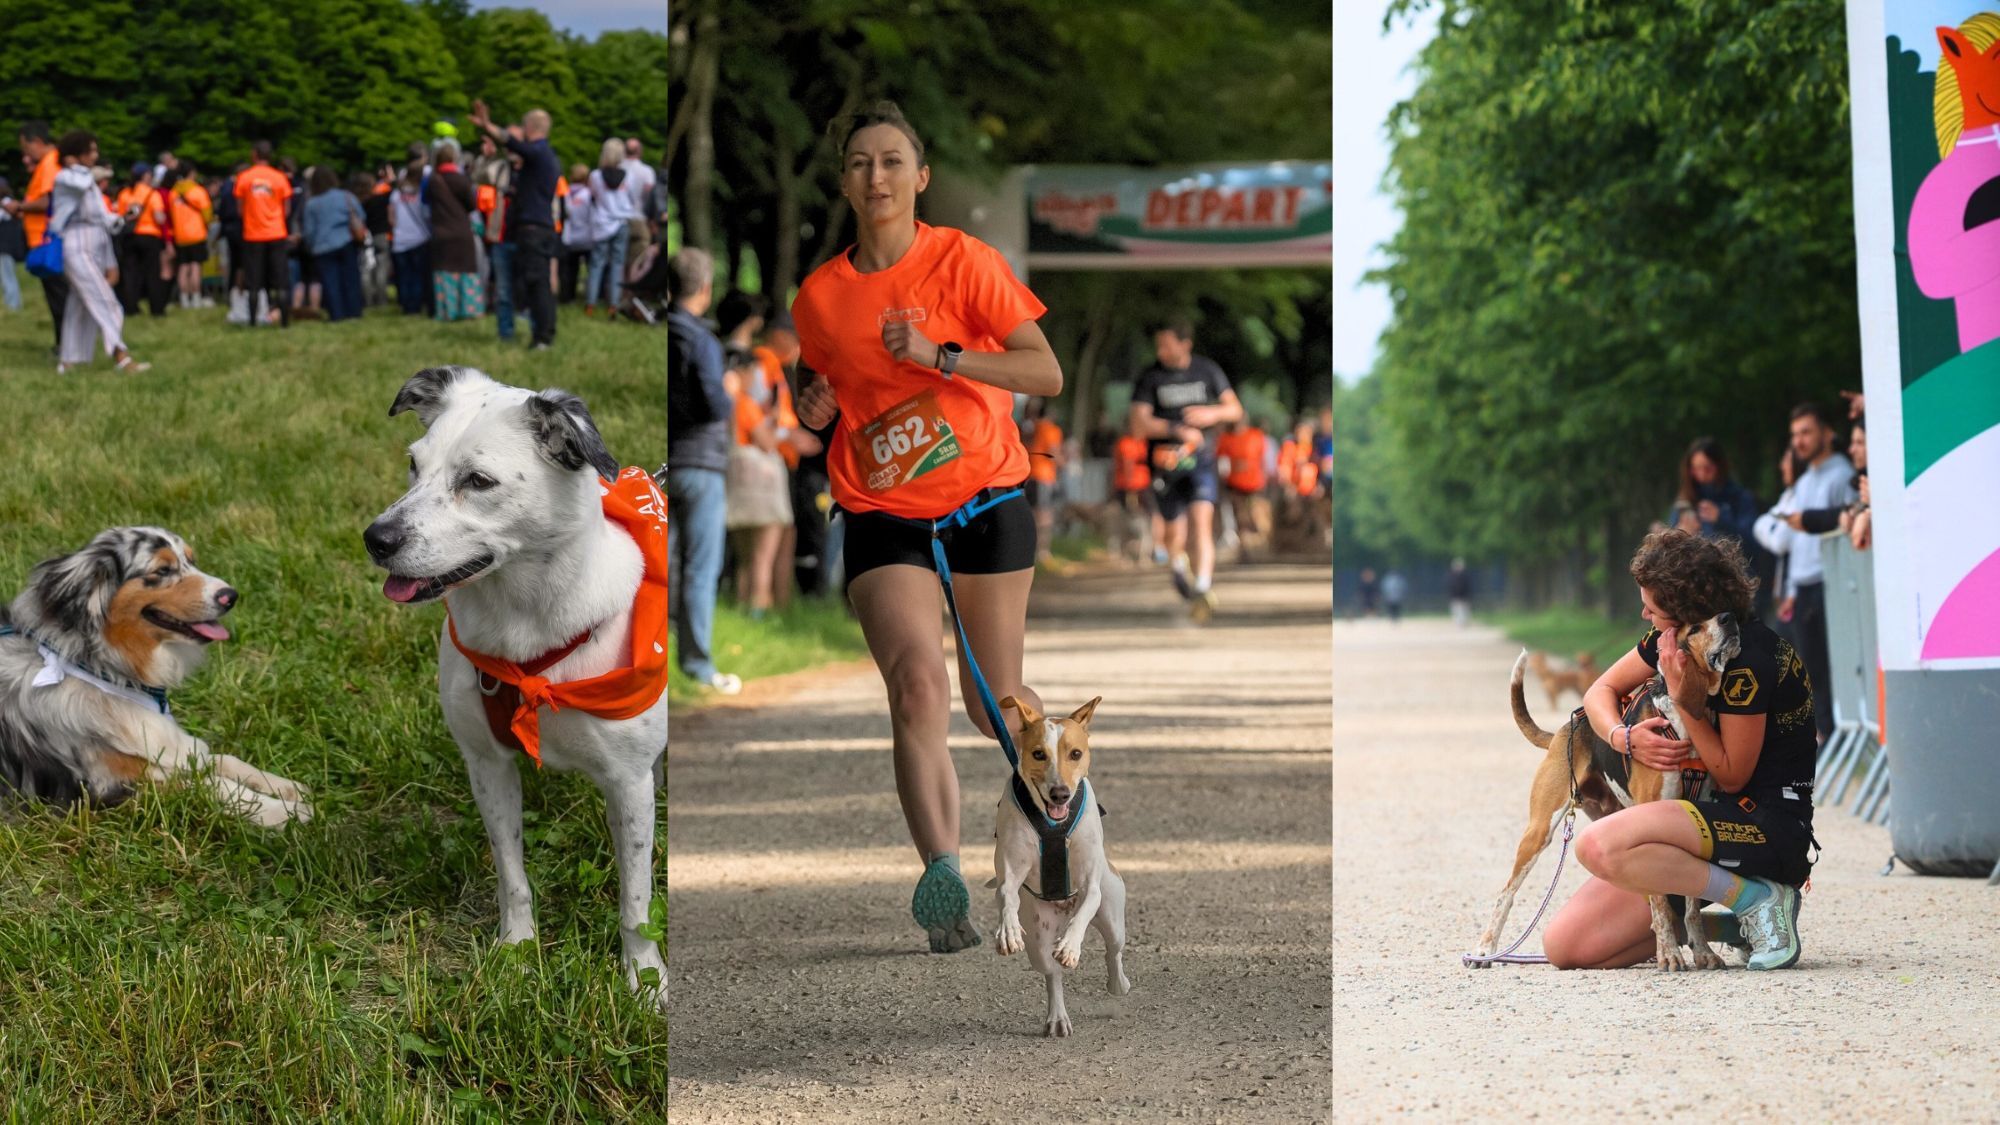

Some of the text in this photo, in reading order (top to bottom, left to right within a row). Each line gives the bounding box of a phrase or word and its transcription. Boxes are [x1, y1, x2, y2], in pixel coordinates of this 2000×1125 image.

[872, 415, 932, 464] 662
[938, 443, 957, 456] 5km
[1717, 831, 1767, 844] BRUSSELS
